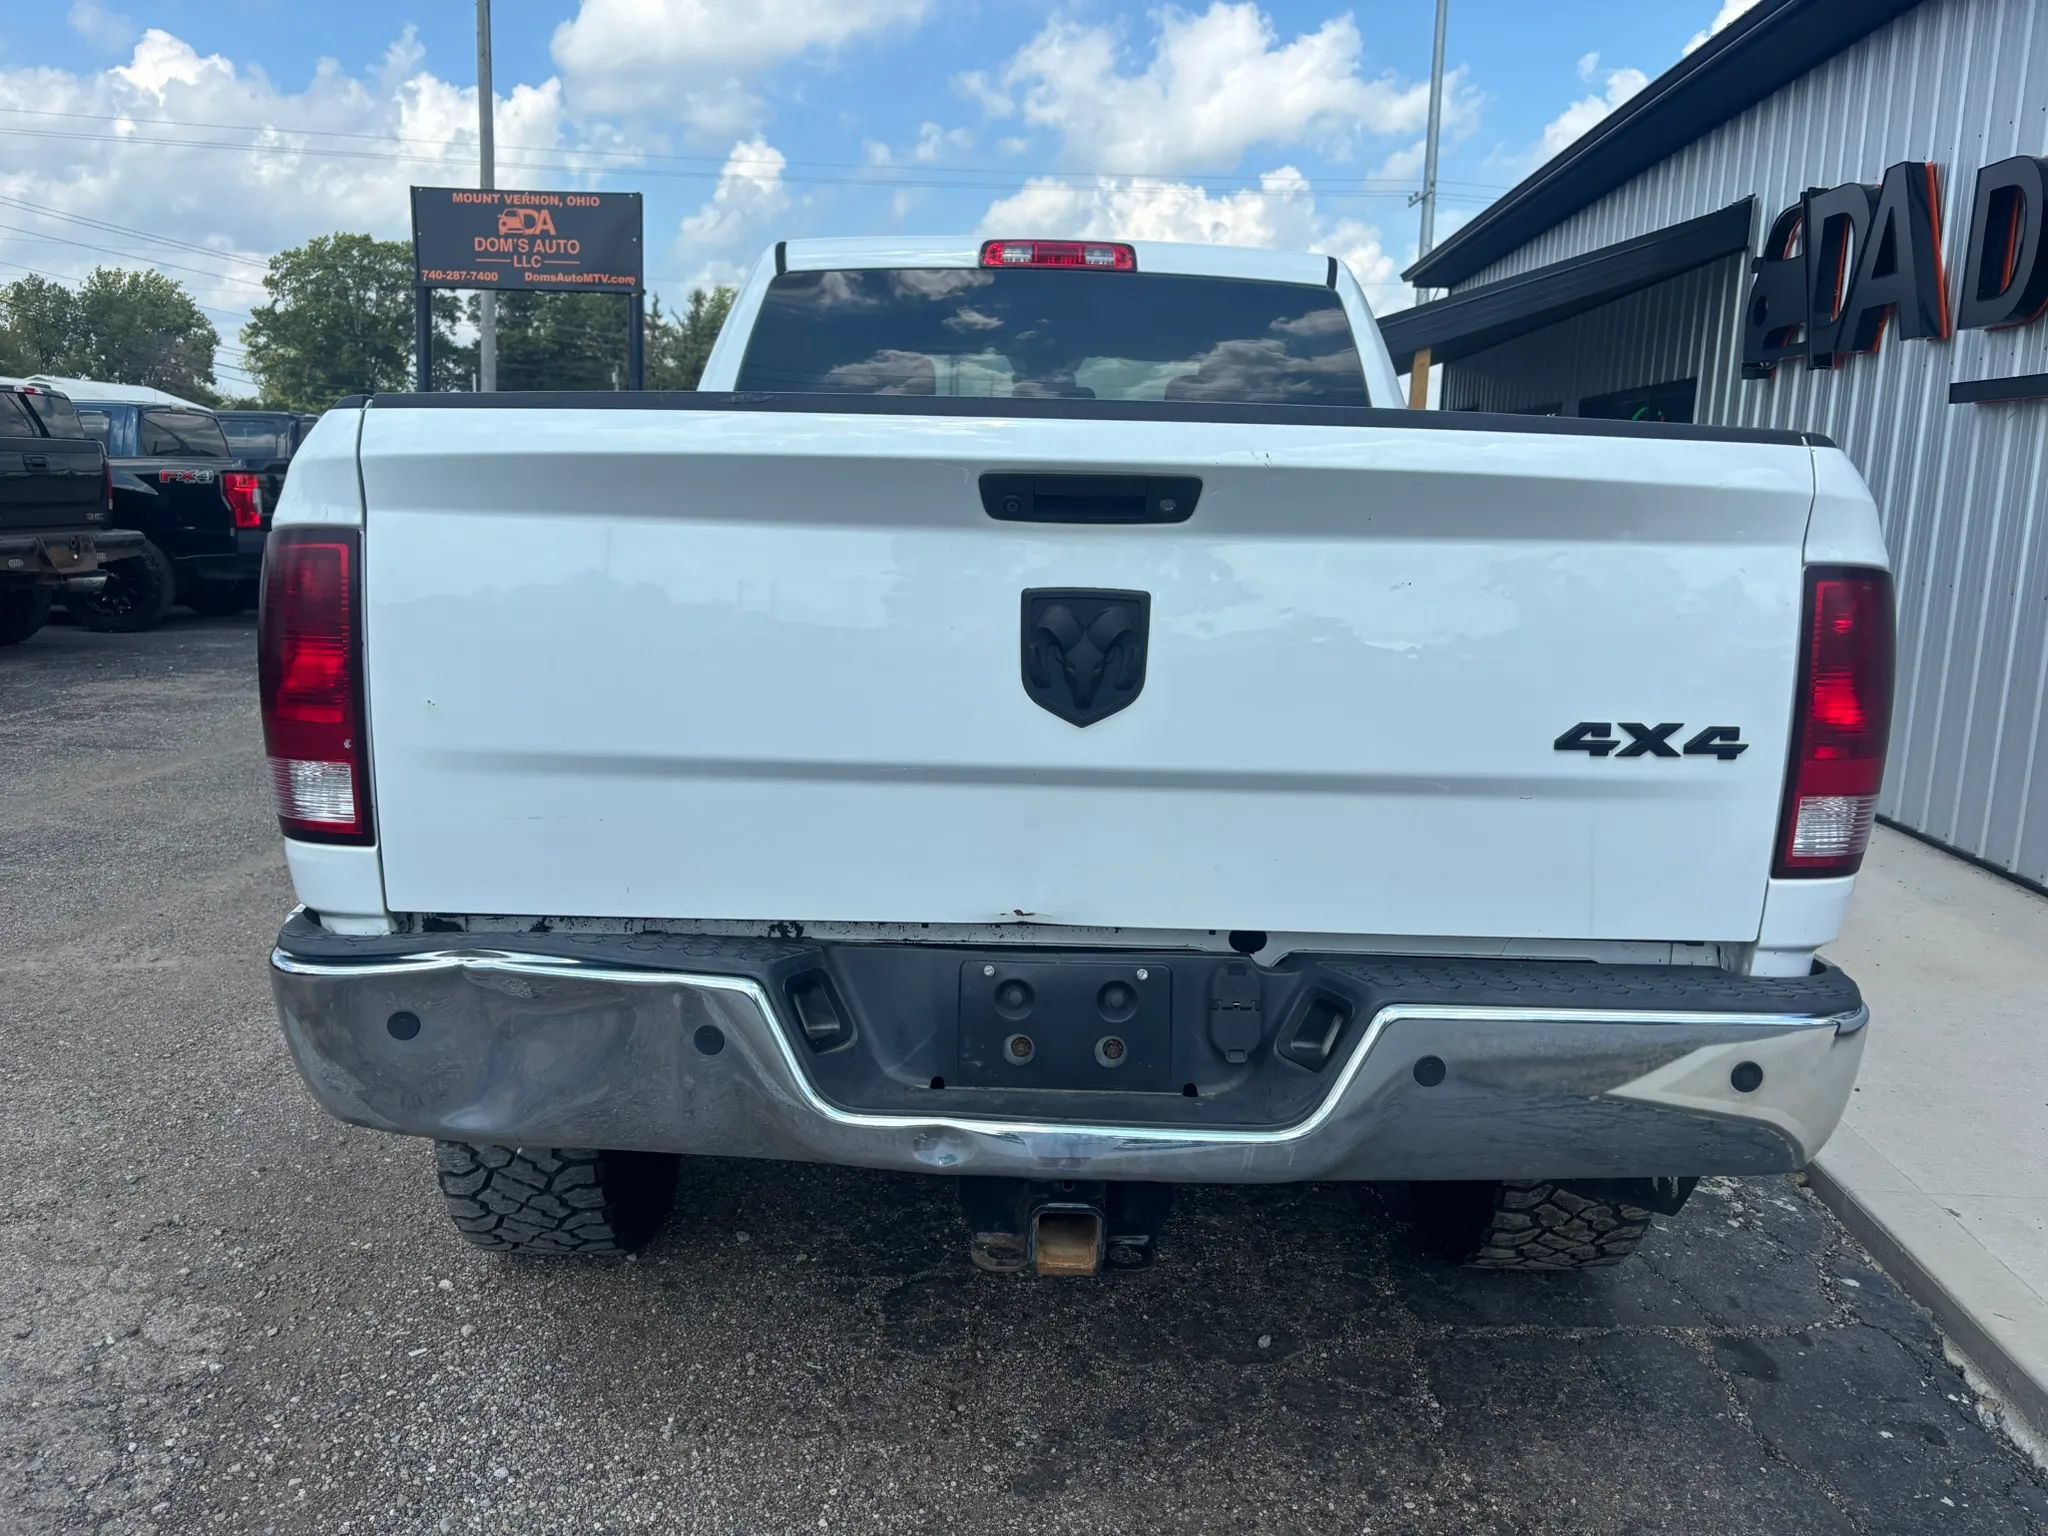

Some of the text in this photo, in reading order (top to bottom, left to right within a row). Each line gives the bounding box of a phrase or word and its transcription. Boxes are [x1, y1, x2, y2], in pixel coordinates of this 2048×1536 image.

[452, 192, 601, 208] MOUNT VERNON, OHIO
[474, 237, 580, 254] DOM'S AUTO
[513, 254, 542, 268] LLC
[421, 270, 499, 281] 740-287-7400
[524, 272, 636, 285] DomsAutoMTV.com
[159, 469, 214, 484] FX4
[1553, 721, 1749, 760] 4X4
